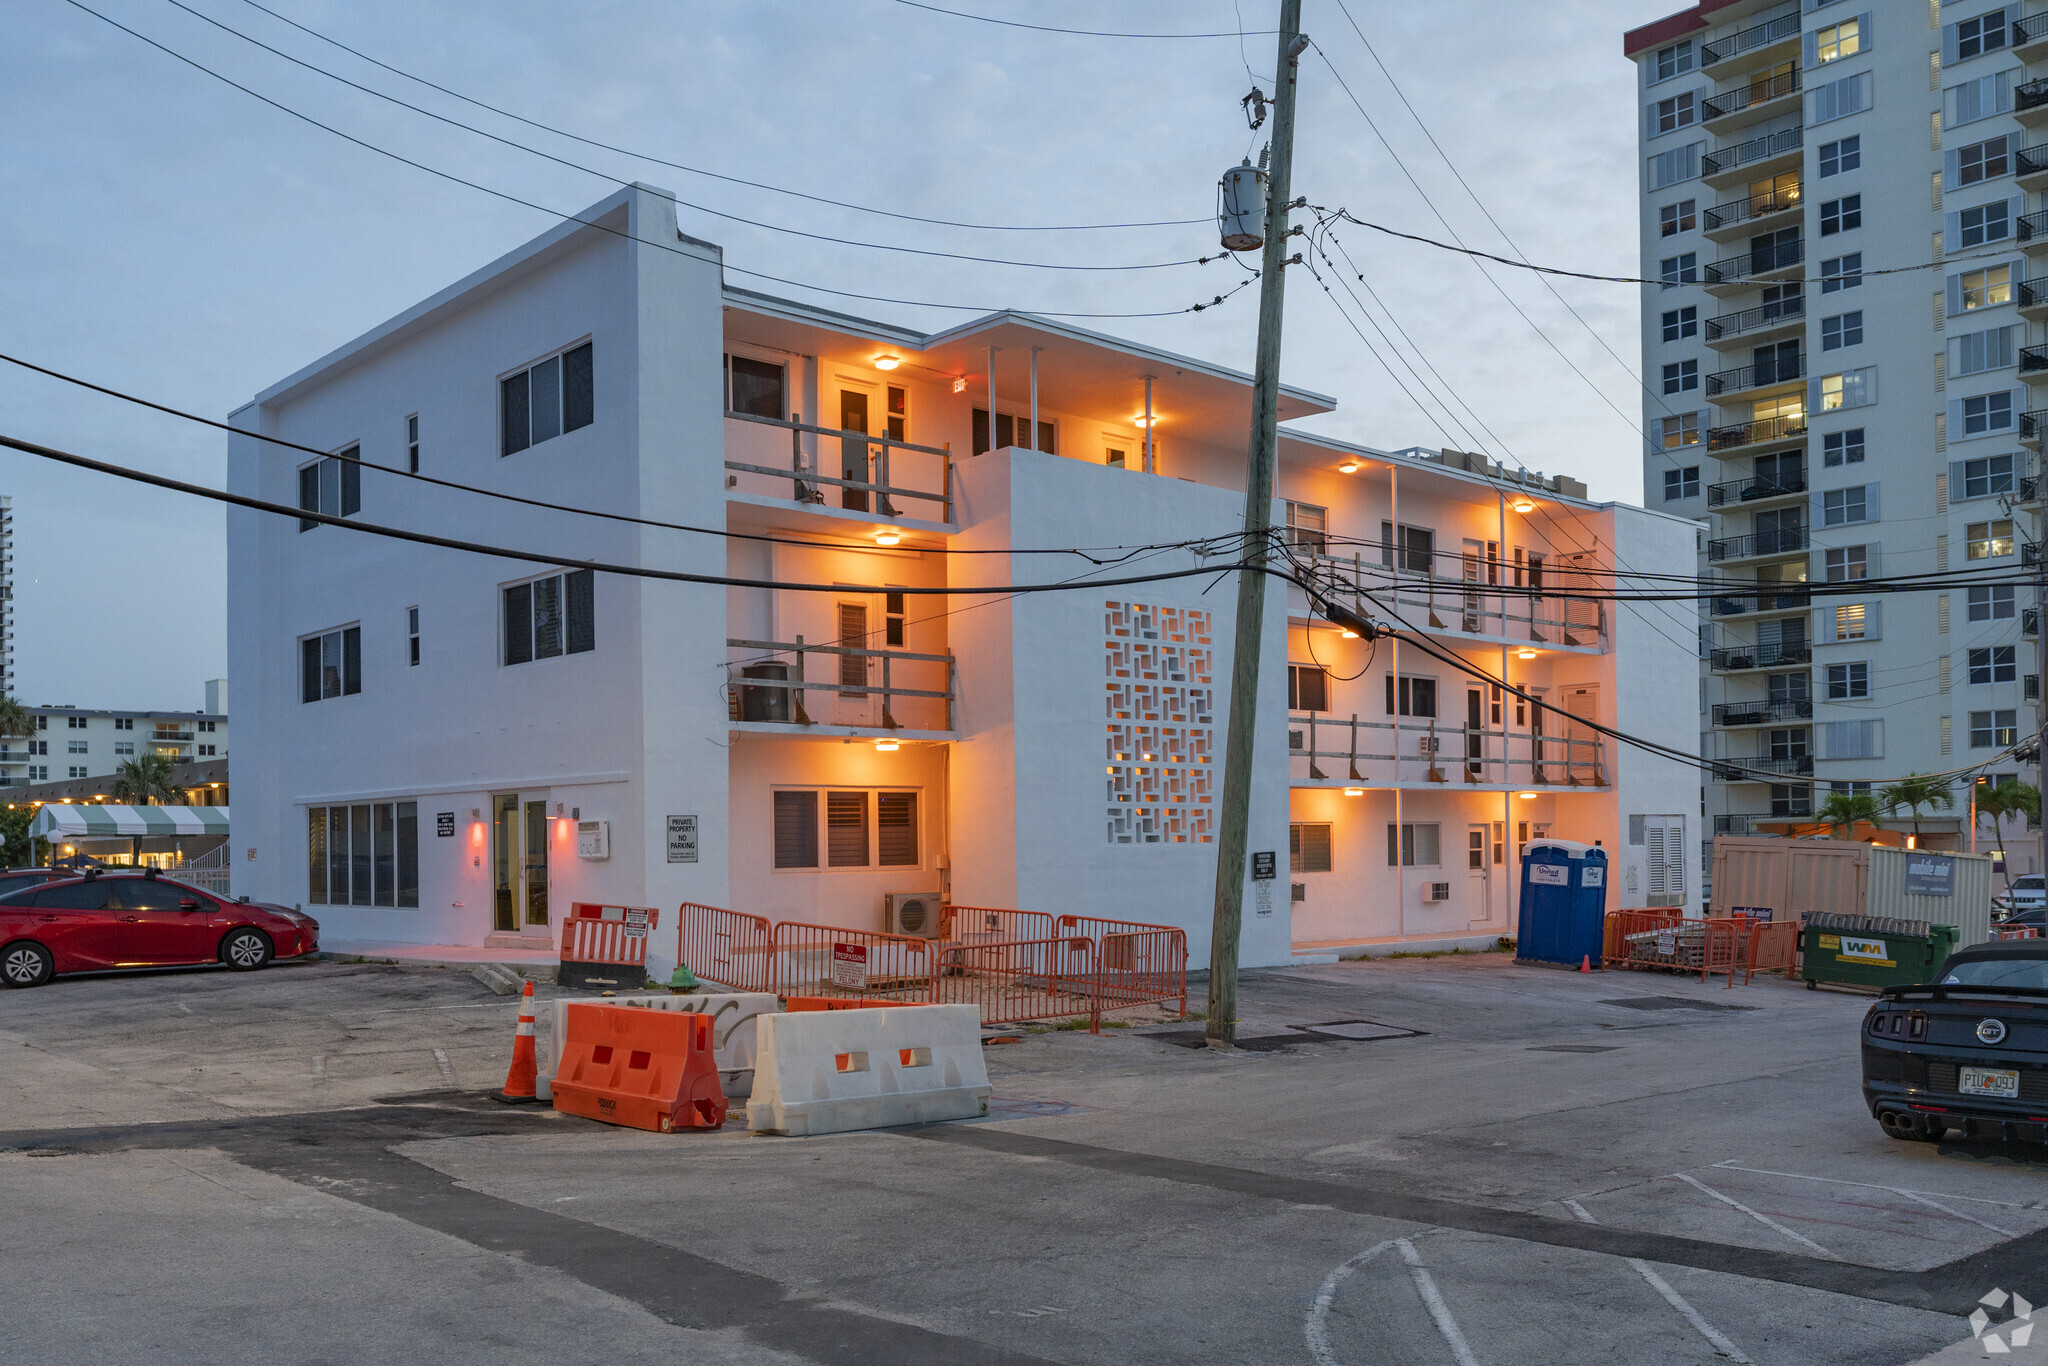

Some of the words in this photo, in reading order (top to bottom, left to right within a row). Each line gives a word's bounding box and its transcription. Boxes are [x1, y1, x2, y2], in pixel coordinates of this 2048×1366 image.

[955, 379, 966, 393] EXIT
[1908, 858, 1935, 876] mobile
[1933, 862, 1951, 877] mini
[1755, 909, 1772, 918] mini
[846, 945, 854, 953] NO
[1846, 941, 1882, 955] WM
[835, 951, 865, 962] TRESPASSING
[839, 975, 860, 985] FELONY
[1982, 1027, 2000, 1035] GT
